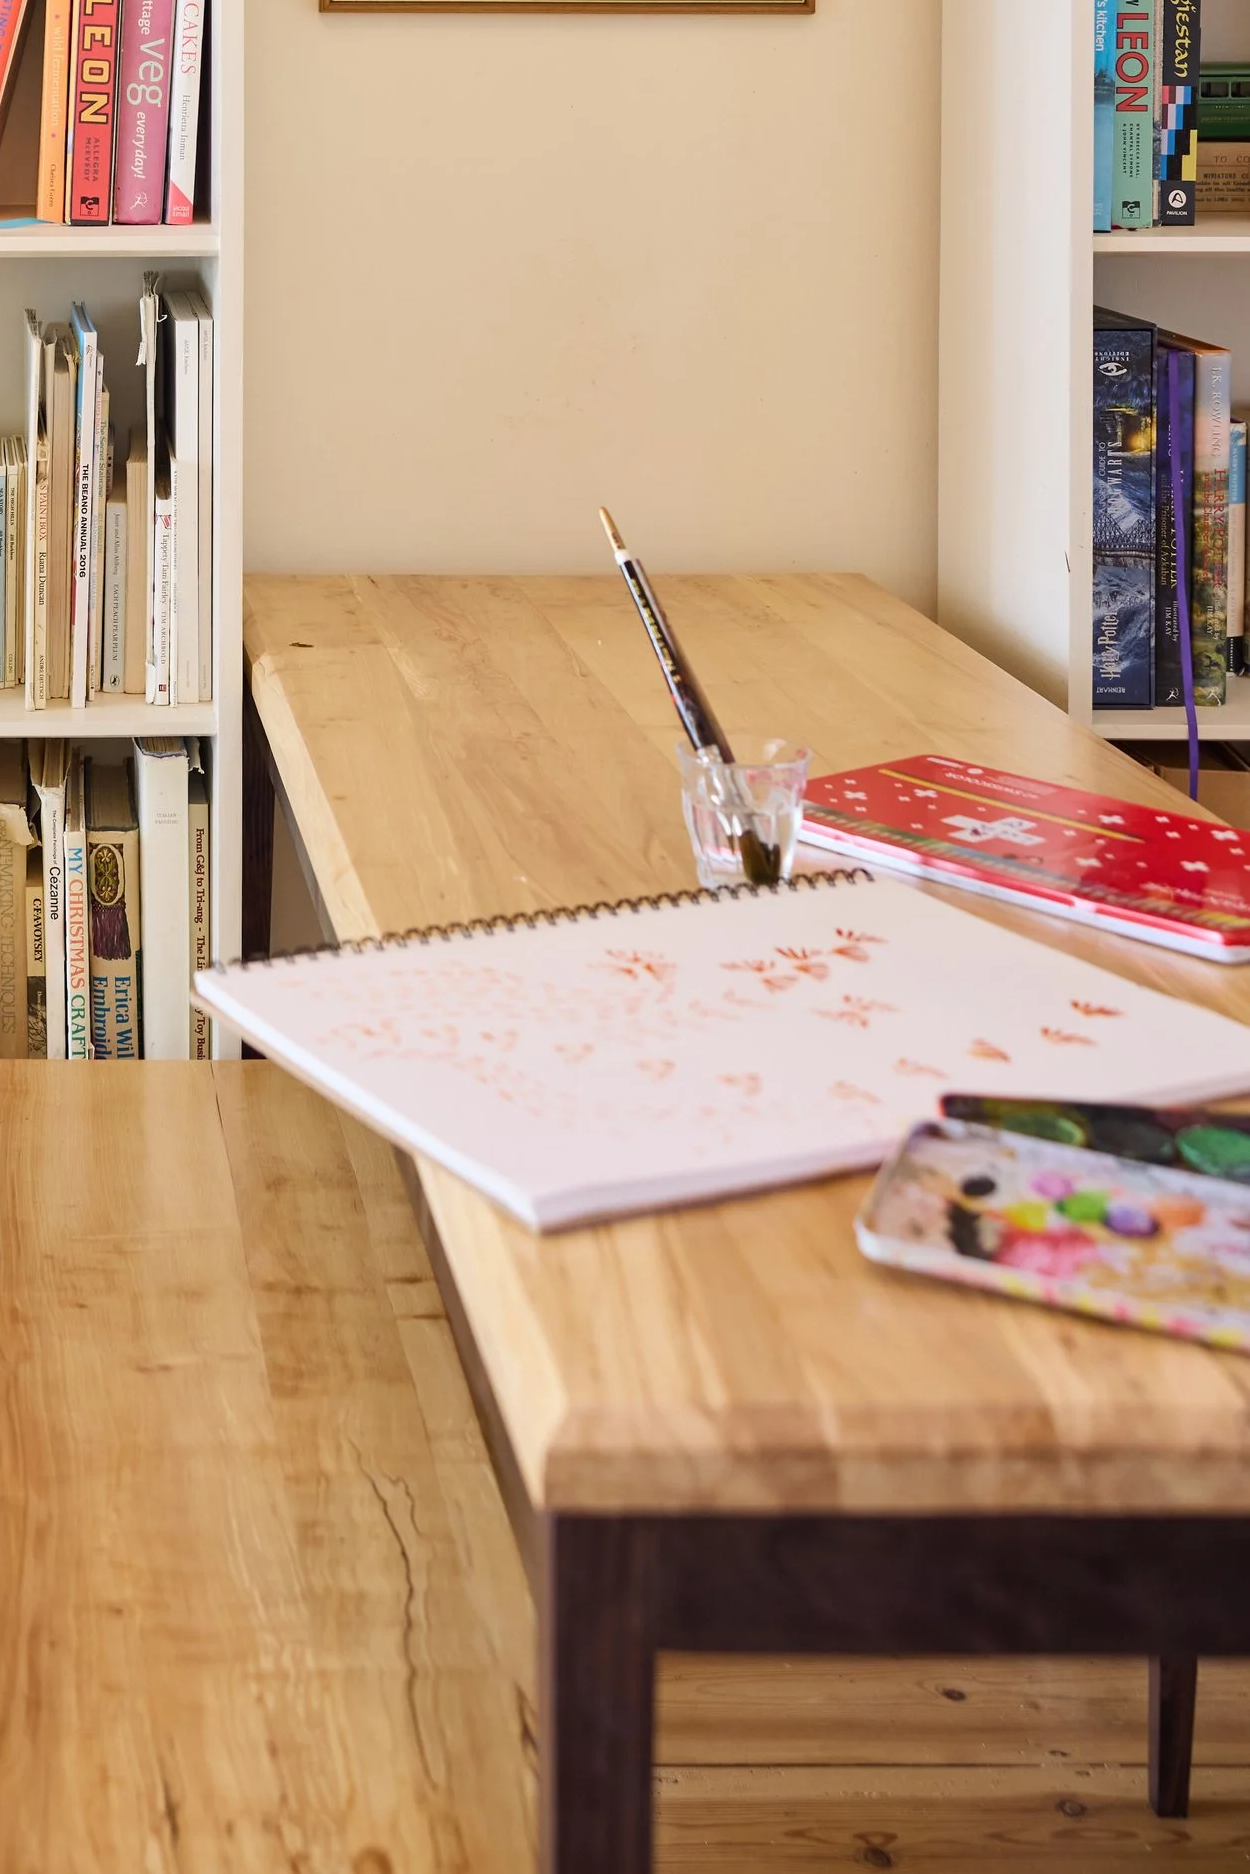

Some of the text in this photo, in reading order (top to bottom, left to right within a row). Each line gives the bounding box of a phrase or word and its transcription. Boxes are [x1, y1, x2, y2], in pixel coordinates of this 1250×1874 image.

[181, 1, 199, 74] CAKES
[1115, 13, 1149, 112] LEON
[127, 39, 164, 107] Veg
[133, 112, 148, 179] everyday!
[81, 482, 90, 514] BEANO
[82, 464, 90, 480] THE
[80, 516, 88, 553] ANNUAL
[50, 867, 60, 920] Cézanne
[69, 847, 85, 990] MY CHRISTMAS
